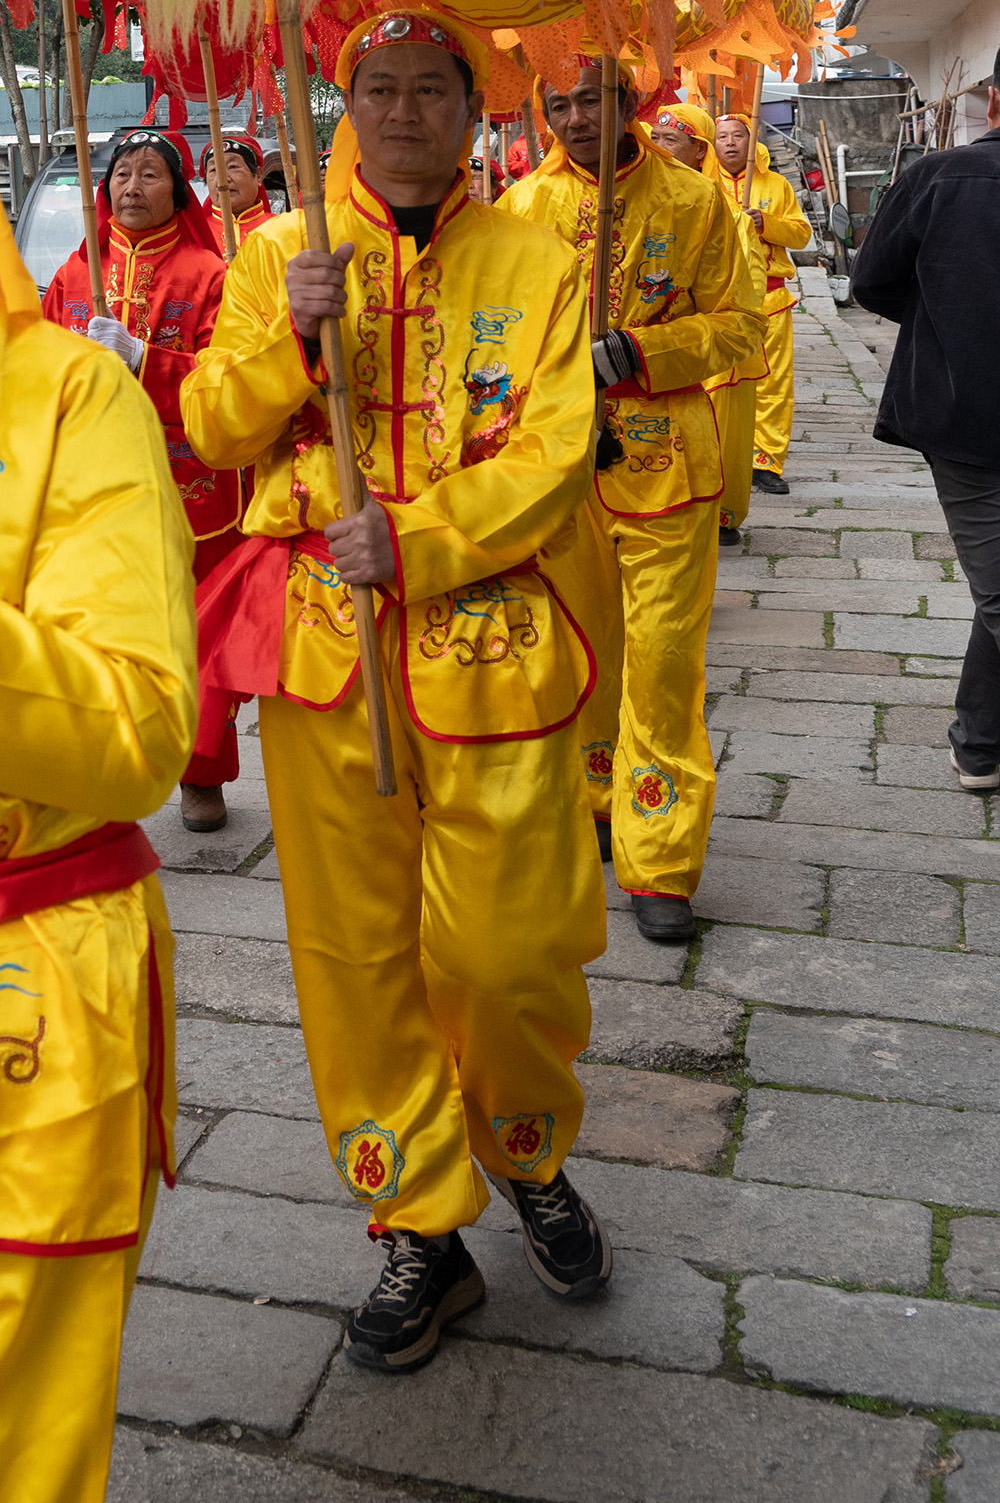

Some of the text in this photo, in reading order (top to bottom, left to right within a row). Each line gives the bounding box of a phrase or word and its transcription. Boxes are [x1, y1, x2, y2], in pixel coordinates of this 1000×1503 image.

[588, 749, 613, 774] 福
[636, 775, 663, 808] 福
[505, 1118, 541, 1156] 福
[353, 1139, 386, 1189] 福
